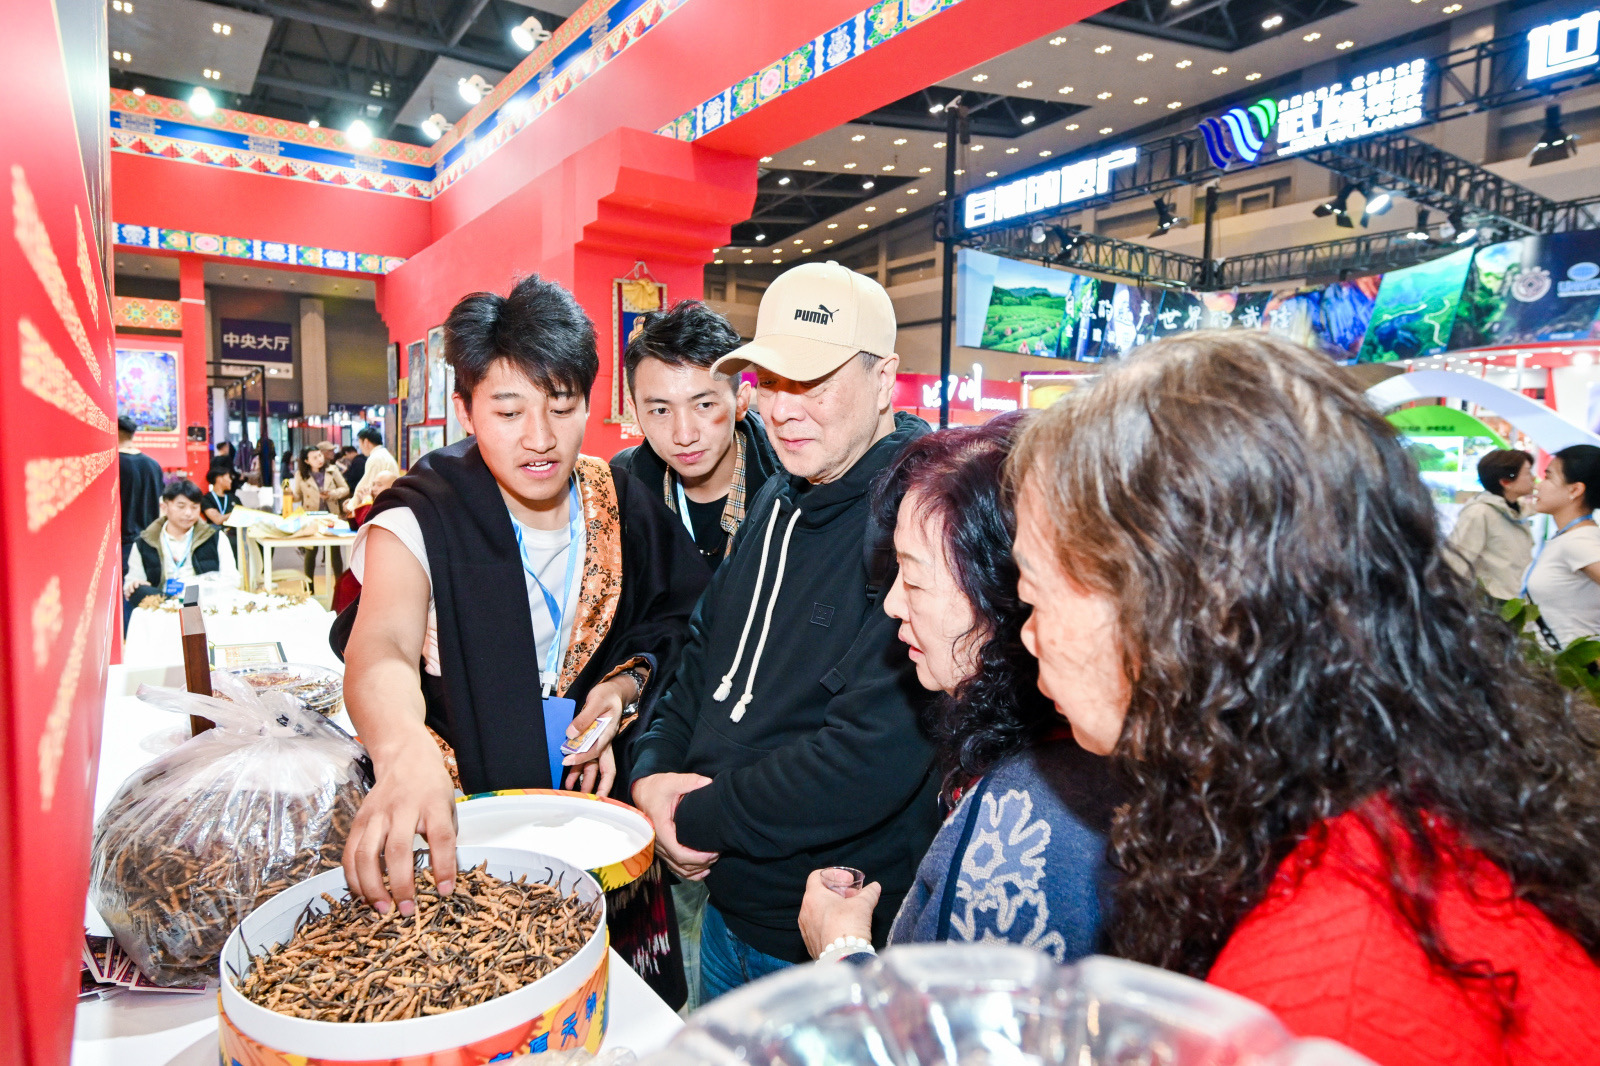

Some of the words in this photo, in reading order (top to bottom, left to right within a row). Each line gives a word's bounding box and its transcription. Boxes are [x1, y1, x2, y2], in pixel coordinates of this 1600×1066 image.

[794, 309, 829, 325] PUMA
[223, 332, 290, 351] 中央大厅
